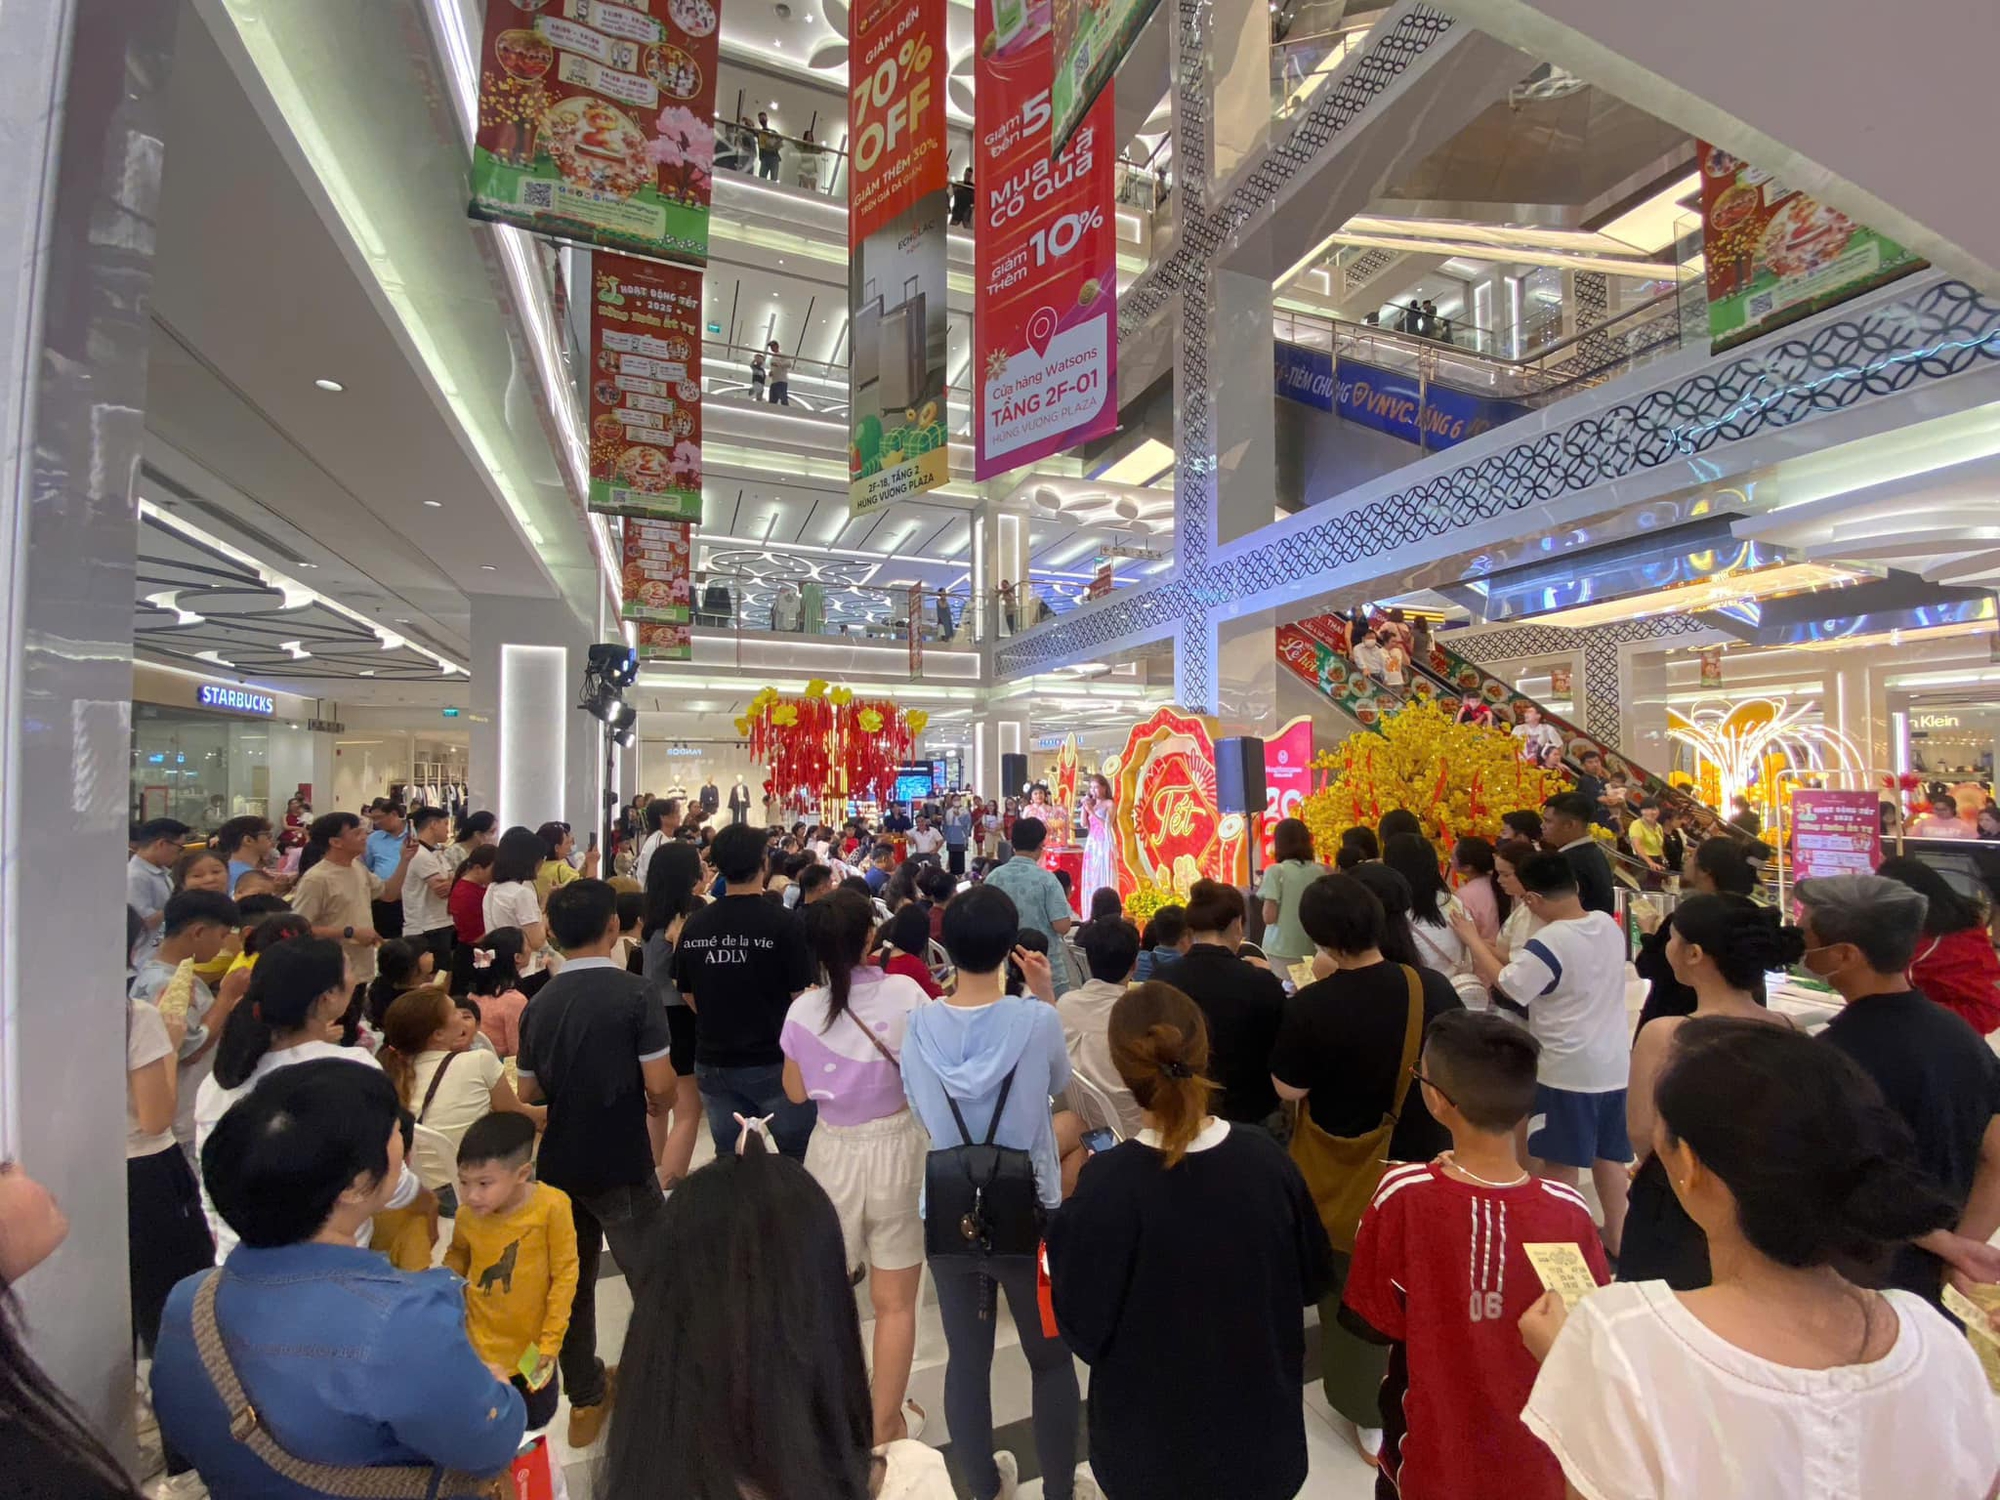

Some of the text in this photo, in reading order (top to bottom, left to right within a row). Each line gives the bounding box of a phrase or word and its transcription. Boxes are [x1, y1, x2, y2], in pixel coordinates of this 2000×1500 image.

[853, 31, 933, 128] 70%
[855, 76, 931, 172] OFF
[913, 137, 939, 160] 30%
[1029, 205, 1104, 267] 10%
[647, 301, 673, 313] 2025
[992, 347, 1098, 401] Cửa hàng Watsons
[992, 368, 1098, 428] TẦNG 2F-01
[1061, 396, 1097, 416] PLAZA
[1450, 420, 1464, 438] 6
[908, 472, 934, 490] PLAZA
[203, 685, 273, 714] STARBUCKS
[1920, 715, 1960, 729] Klein
[1152, 784, 1207, 846] Tết
[683, 934, 774, 949] acmé de la vie
[705, 949, 748, 964] ADLV
[1469, 1290, 1504, 1323] 06
